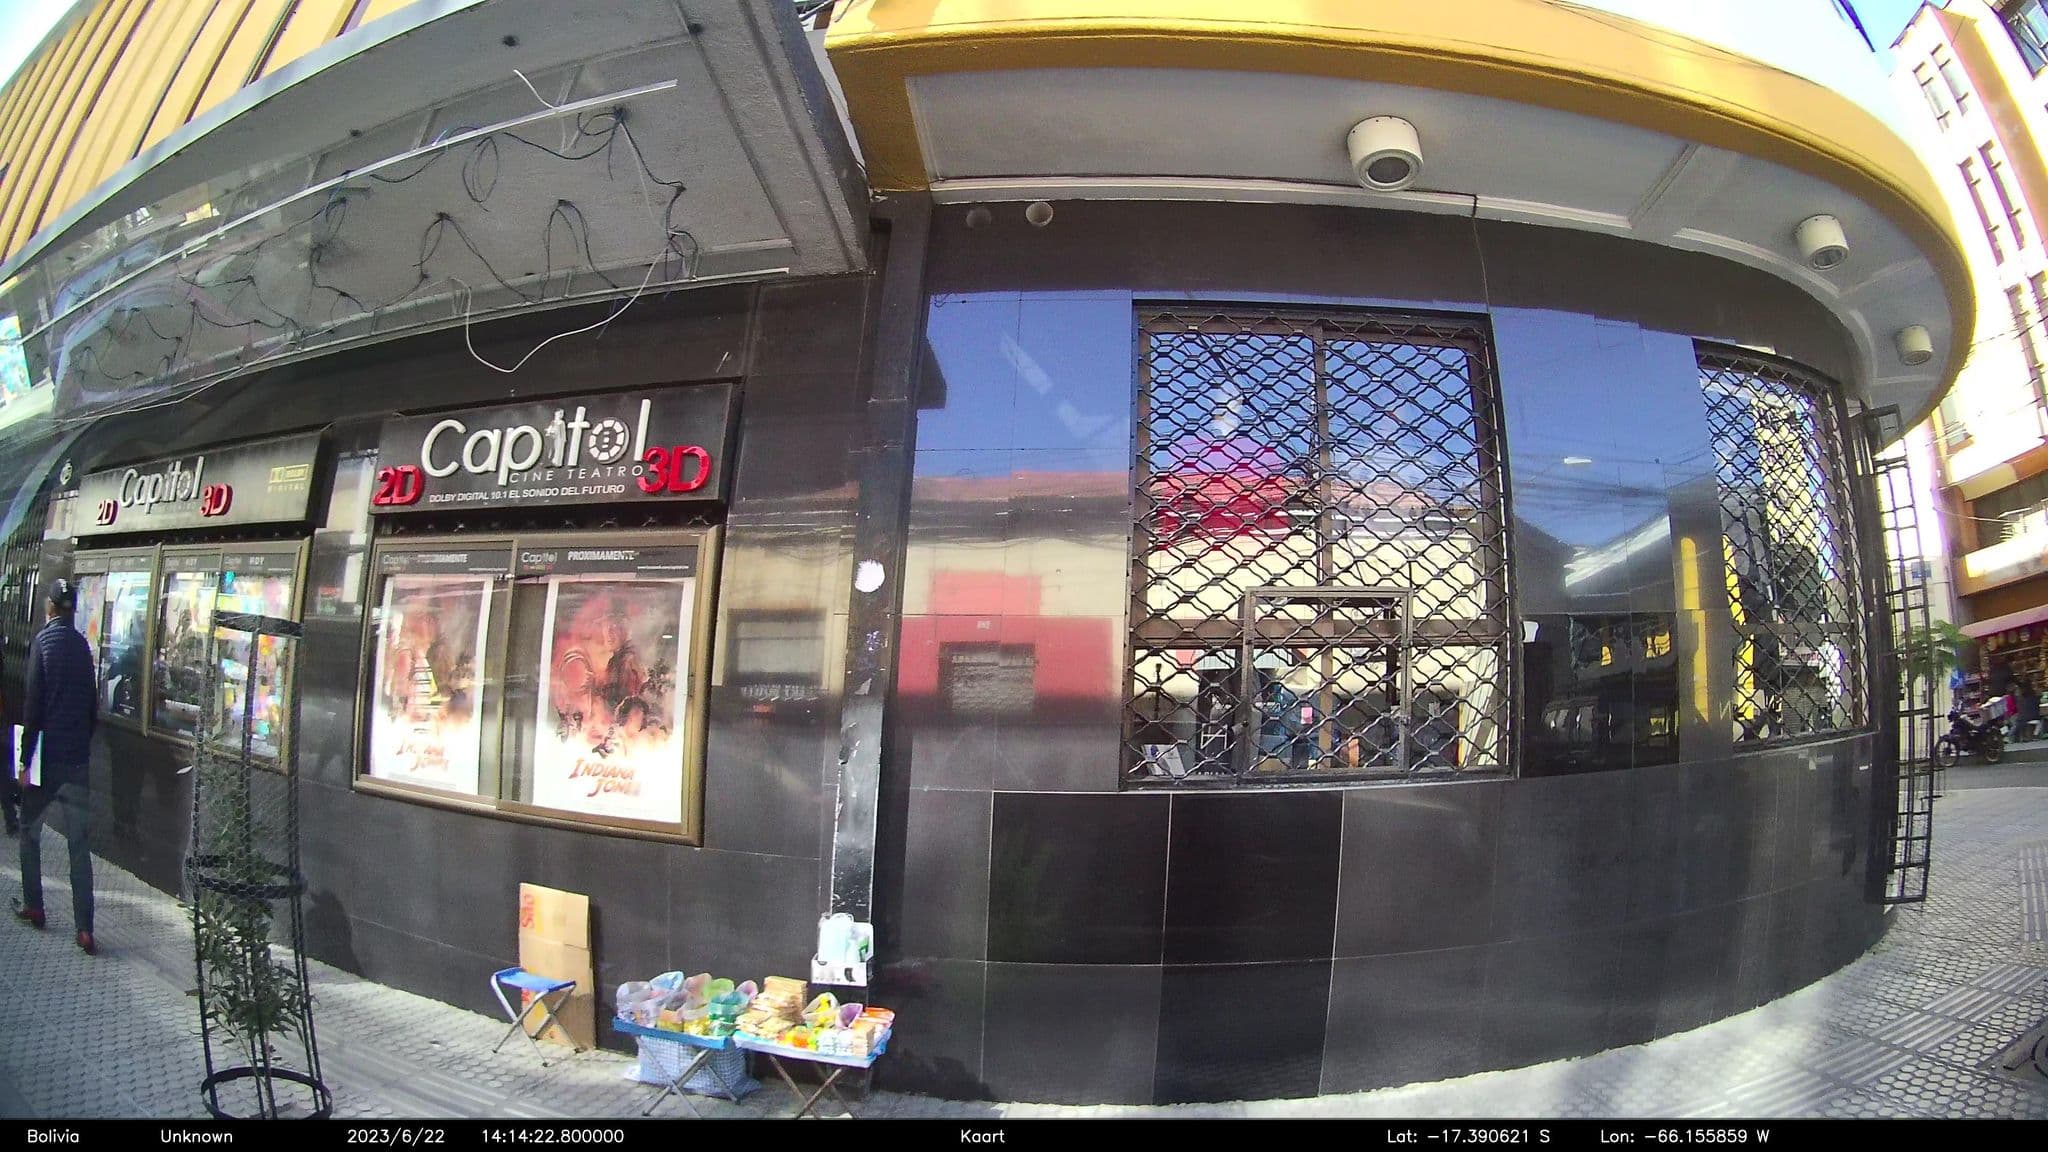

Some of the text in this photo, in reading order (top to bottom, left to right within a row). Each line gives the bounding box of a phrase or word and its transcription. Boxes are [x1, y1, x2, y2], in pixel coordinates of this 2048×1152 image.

[421, 399, 651, 486] Capitol
[119, 456, 205, 514] Capitol
[373, 465, 425, 506] 2D
[508, 464, 644, 484] CINE TEATRO
[636, 445, 713, 494] 3D
[95, 499, 119, 526] 2D
[199, 483, 233, 518] 3D
[429, 493, 457, 503] DOLBY
[457, 491, 490, 502] DIGITAL
[508, 489, 520, 499] EL
[522, 487, 559, 498] SONIDO
[561, 486, 580, 496] DEL
[582, 484, 625, 495] FUTURO
